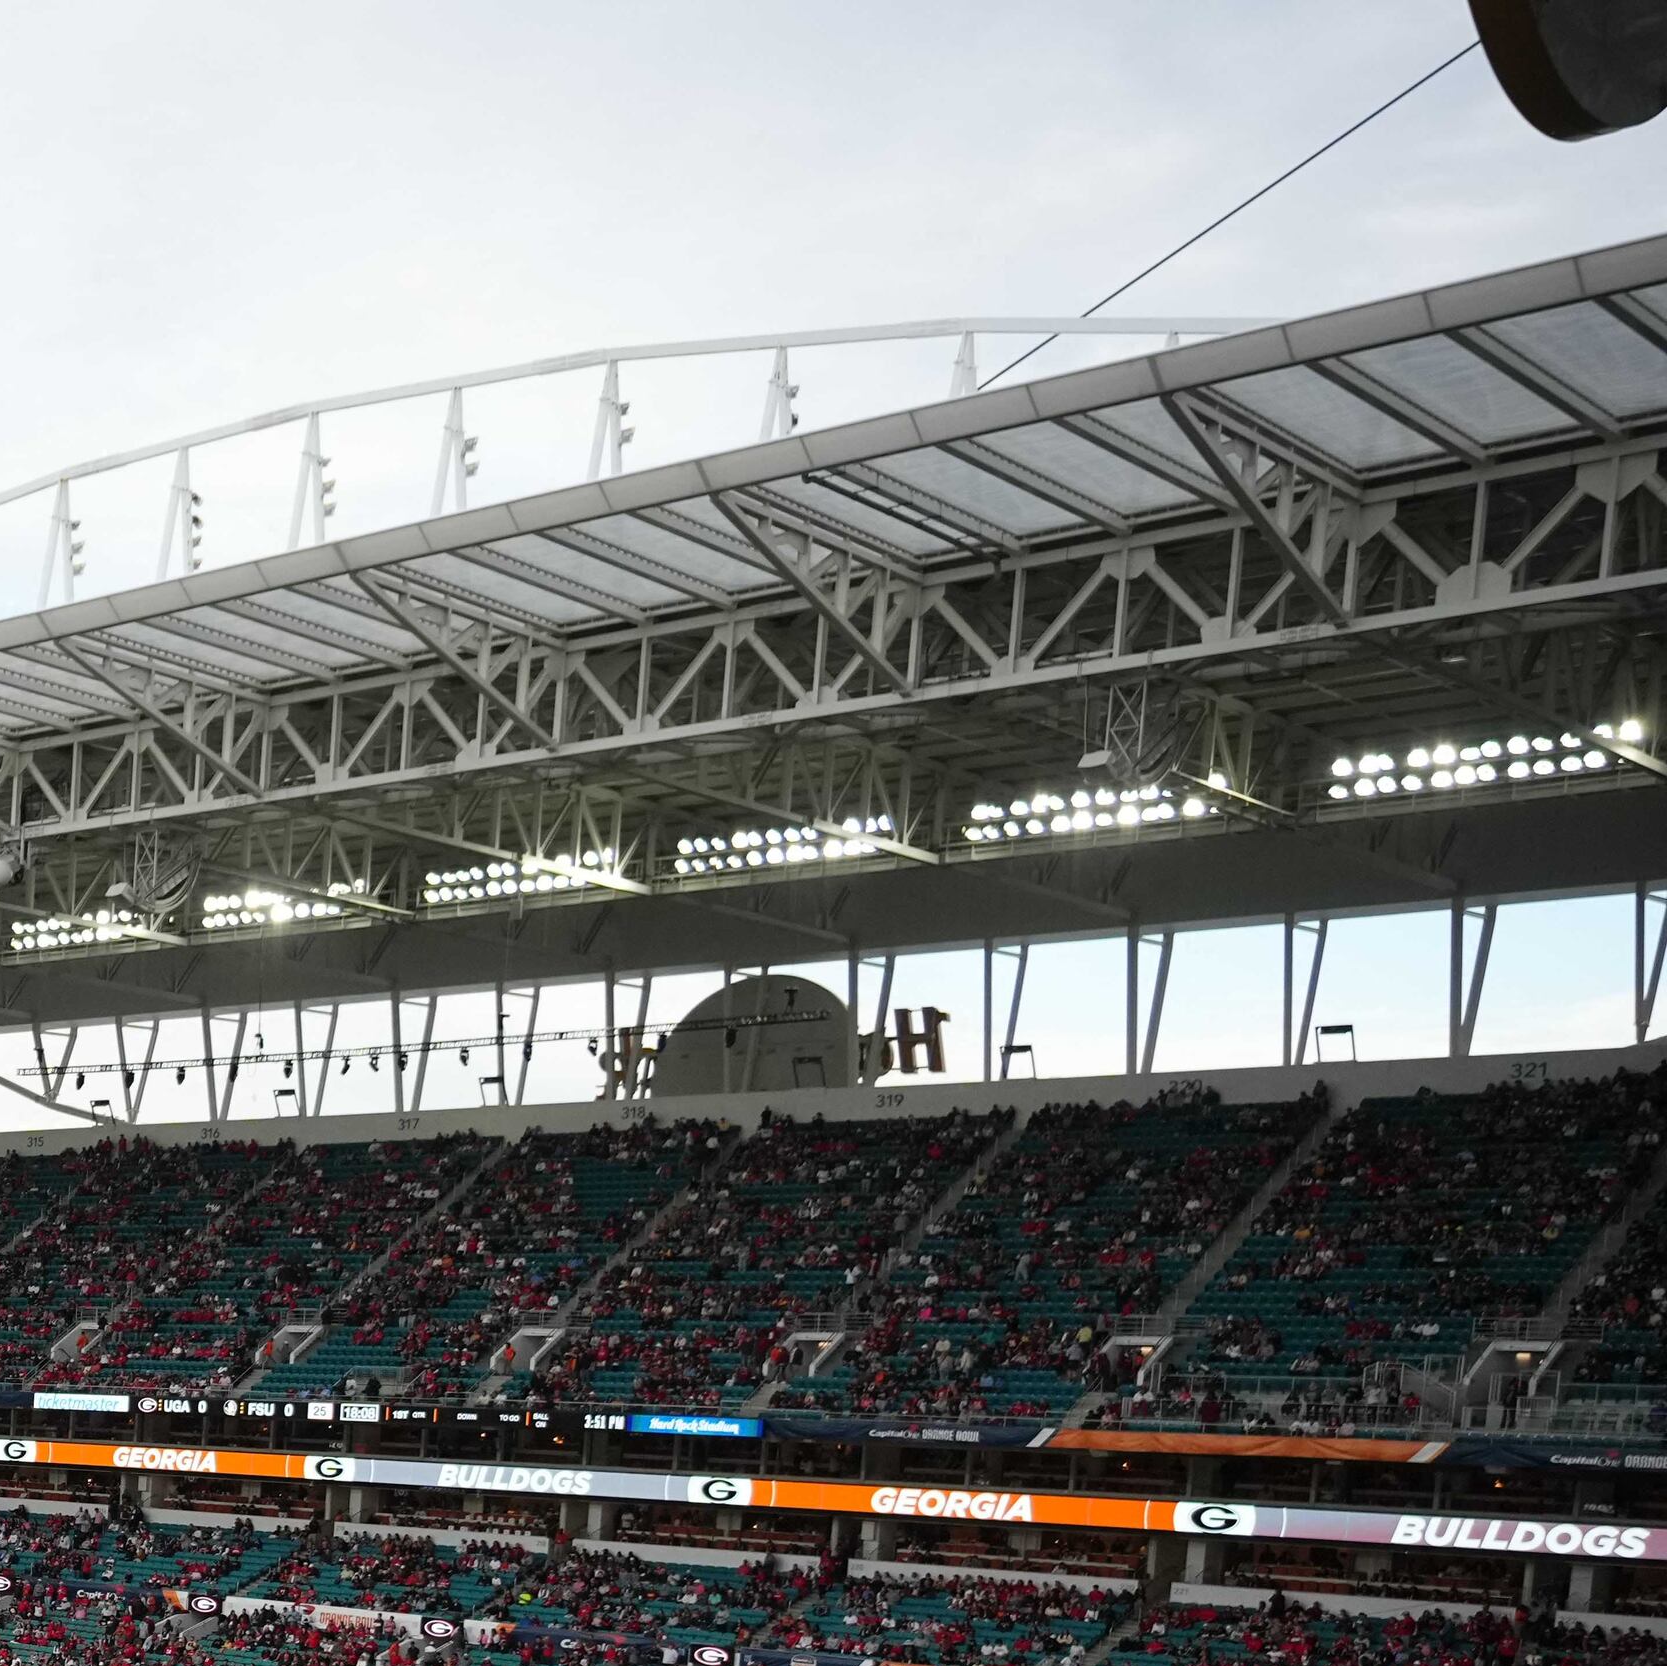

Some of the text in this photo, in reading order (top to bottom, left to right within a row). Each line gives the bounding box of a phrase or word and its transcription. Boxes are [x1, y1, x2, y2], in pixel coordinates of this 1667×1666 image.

[1511, 1062, 1547, 1079] 321
[875, 1094, 904, 1108] 319
[622, 1106, 646, 1119] 318
[398, 1118, 420, 1130] 317
[201, 1127, 220, 1139] 316
[27, 1136, 44, 1148] 315
[164, 1399, 191, 1414] UGA
[247, 1402, 275, 1416] FSU
[112, 1446, 218, 1473] GEORGIA
[436, 1464, 592, 1495] BULLDOGS
[870, 1487, 1033, 1521] GEORGIA
[1389, 1516, 1651, 1559] BULLDOGS
